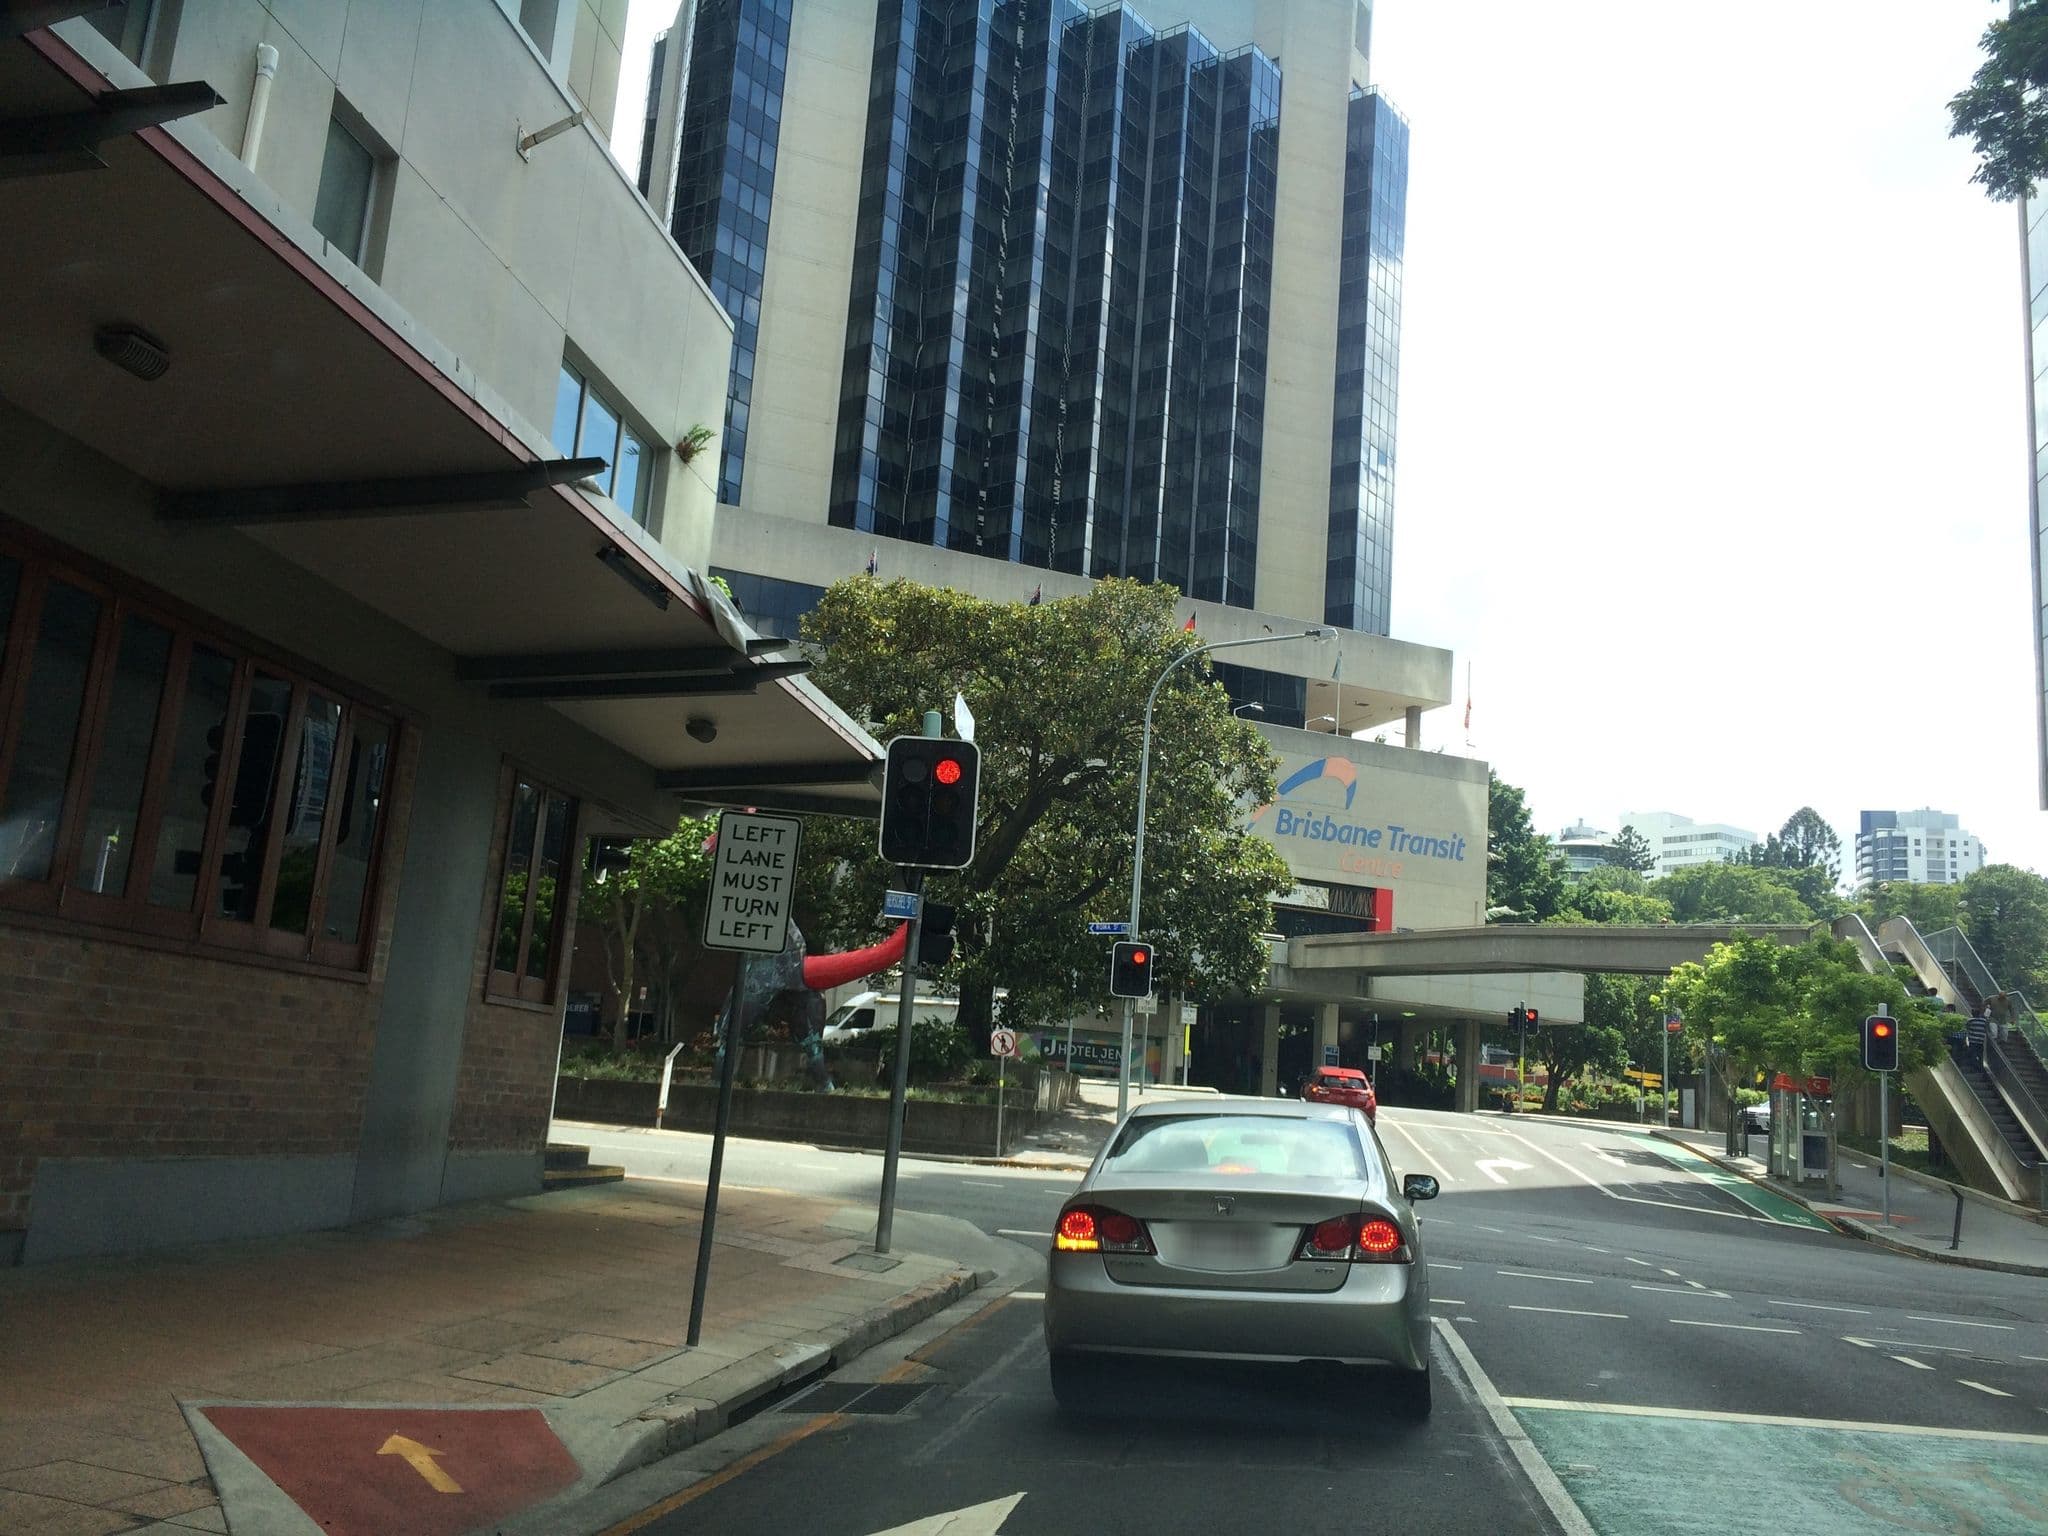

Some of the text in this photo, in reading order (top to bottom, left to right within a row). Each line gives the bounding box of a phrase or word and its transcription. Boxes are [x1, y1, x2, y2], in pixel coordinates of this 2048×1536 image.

[732, 824, 786, 845] LEFT
[1275, 808, 1466, 861] Brisbane Transit
[726, 848, 785, 869] LANE
[1340, 852, 1403, 879] Centre
[723, 872, 783, 893] MUST
[722, 896, 779, 917] TURN
[719, 920, 773, 941] LEFT
[1058, 1043, 1122, 1060] HOTEL JEN
